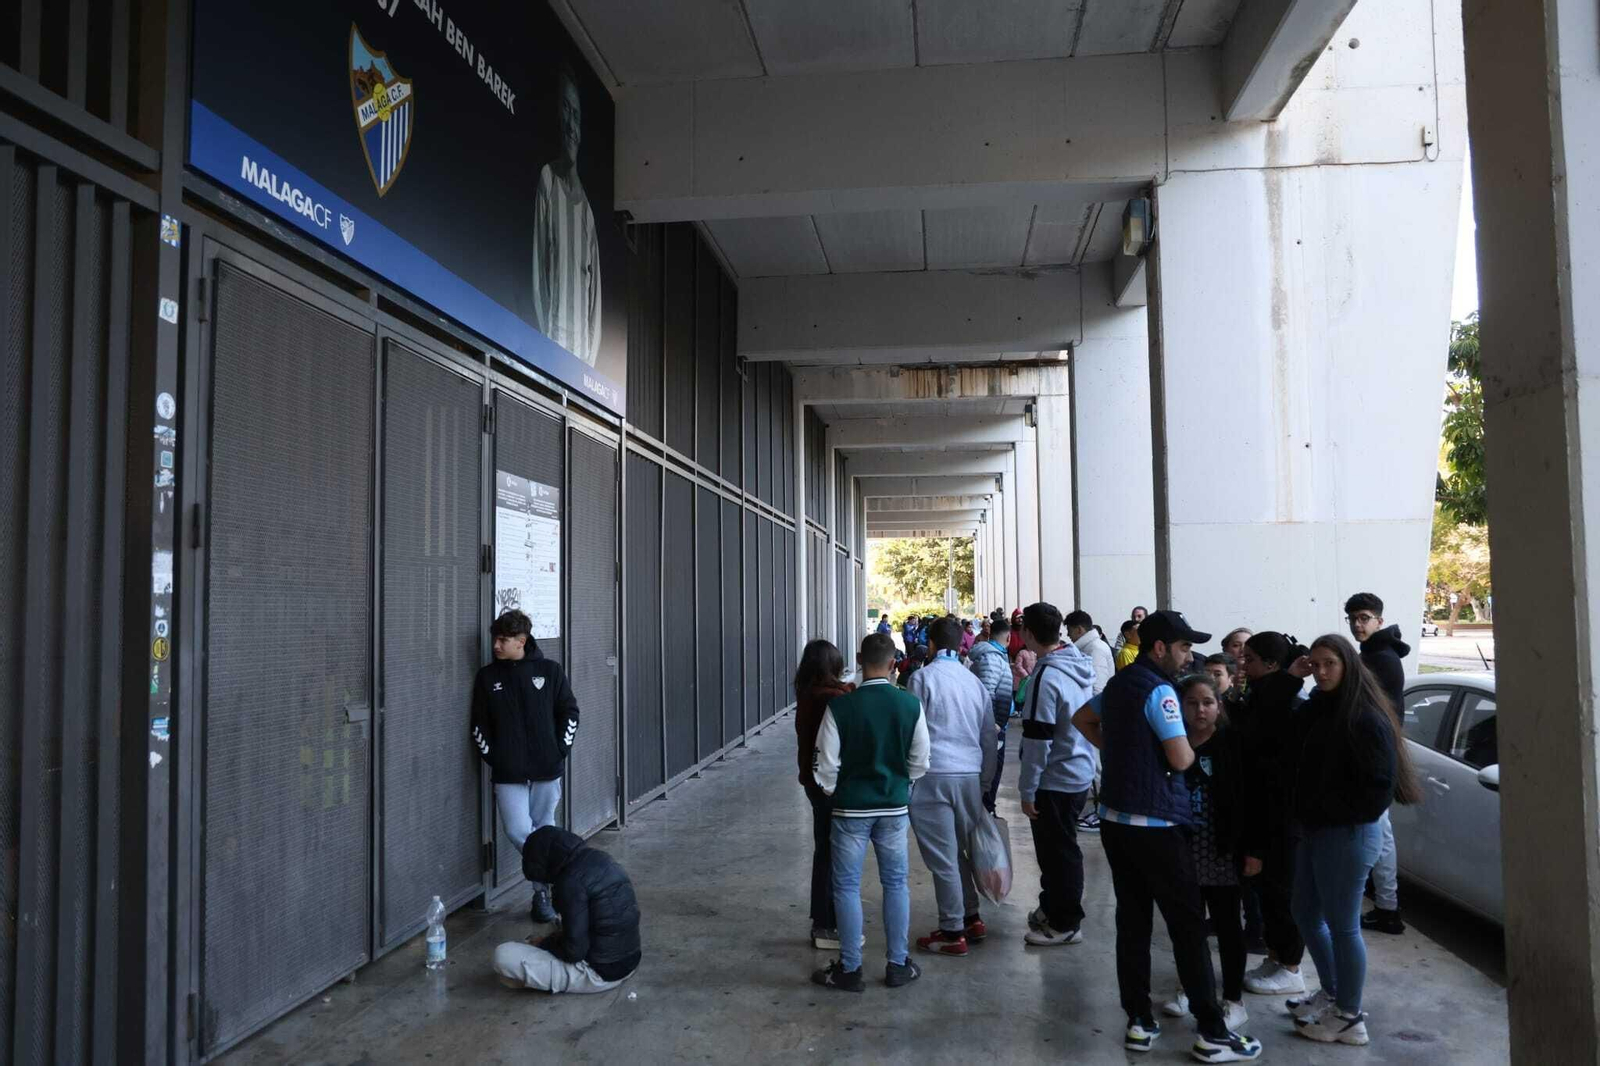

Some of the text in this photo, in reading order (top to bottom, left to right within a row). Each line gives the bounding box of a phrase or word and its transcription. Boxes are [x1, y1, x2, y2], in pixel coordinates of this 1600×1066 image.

[412, 0, 516, 115] AH BEN BAREK
[241, 156, 332, 229] MALAGACF
